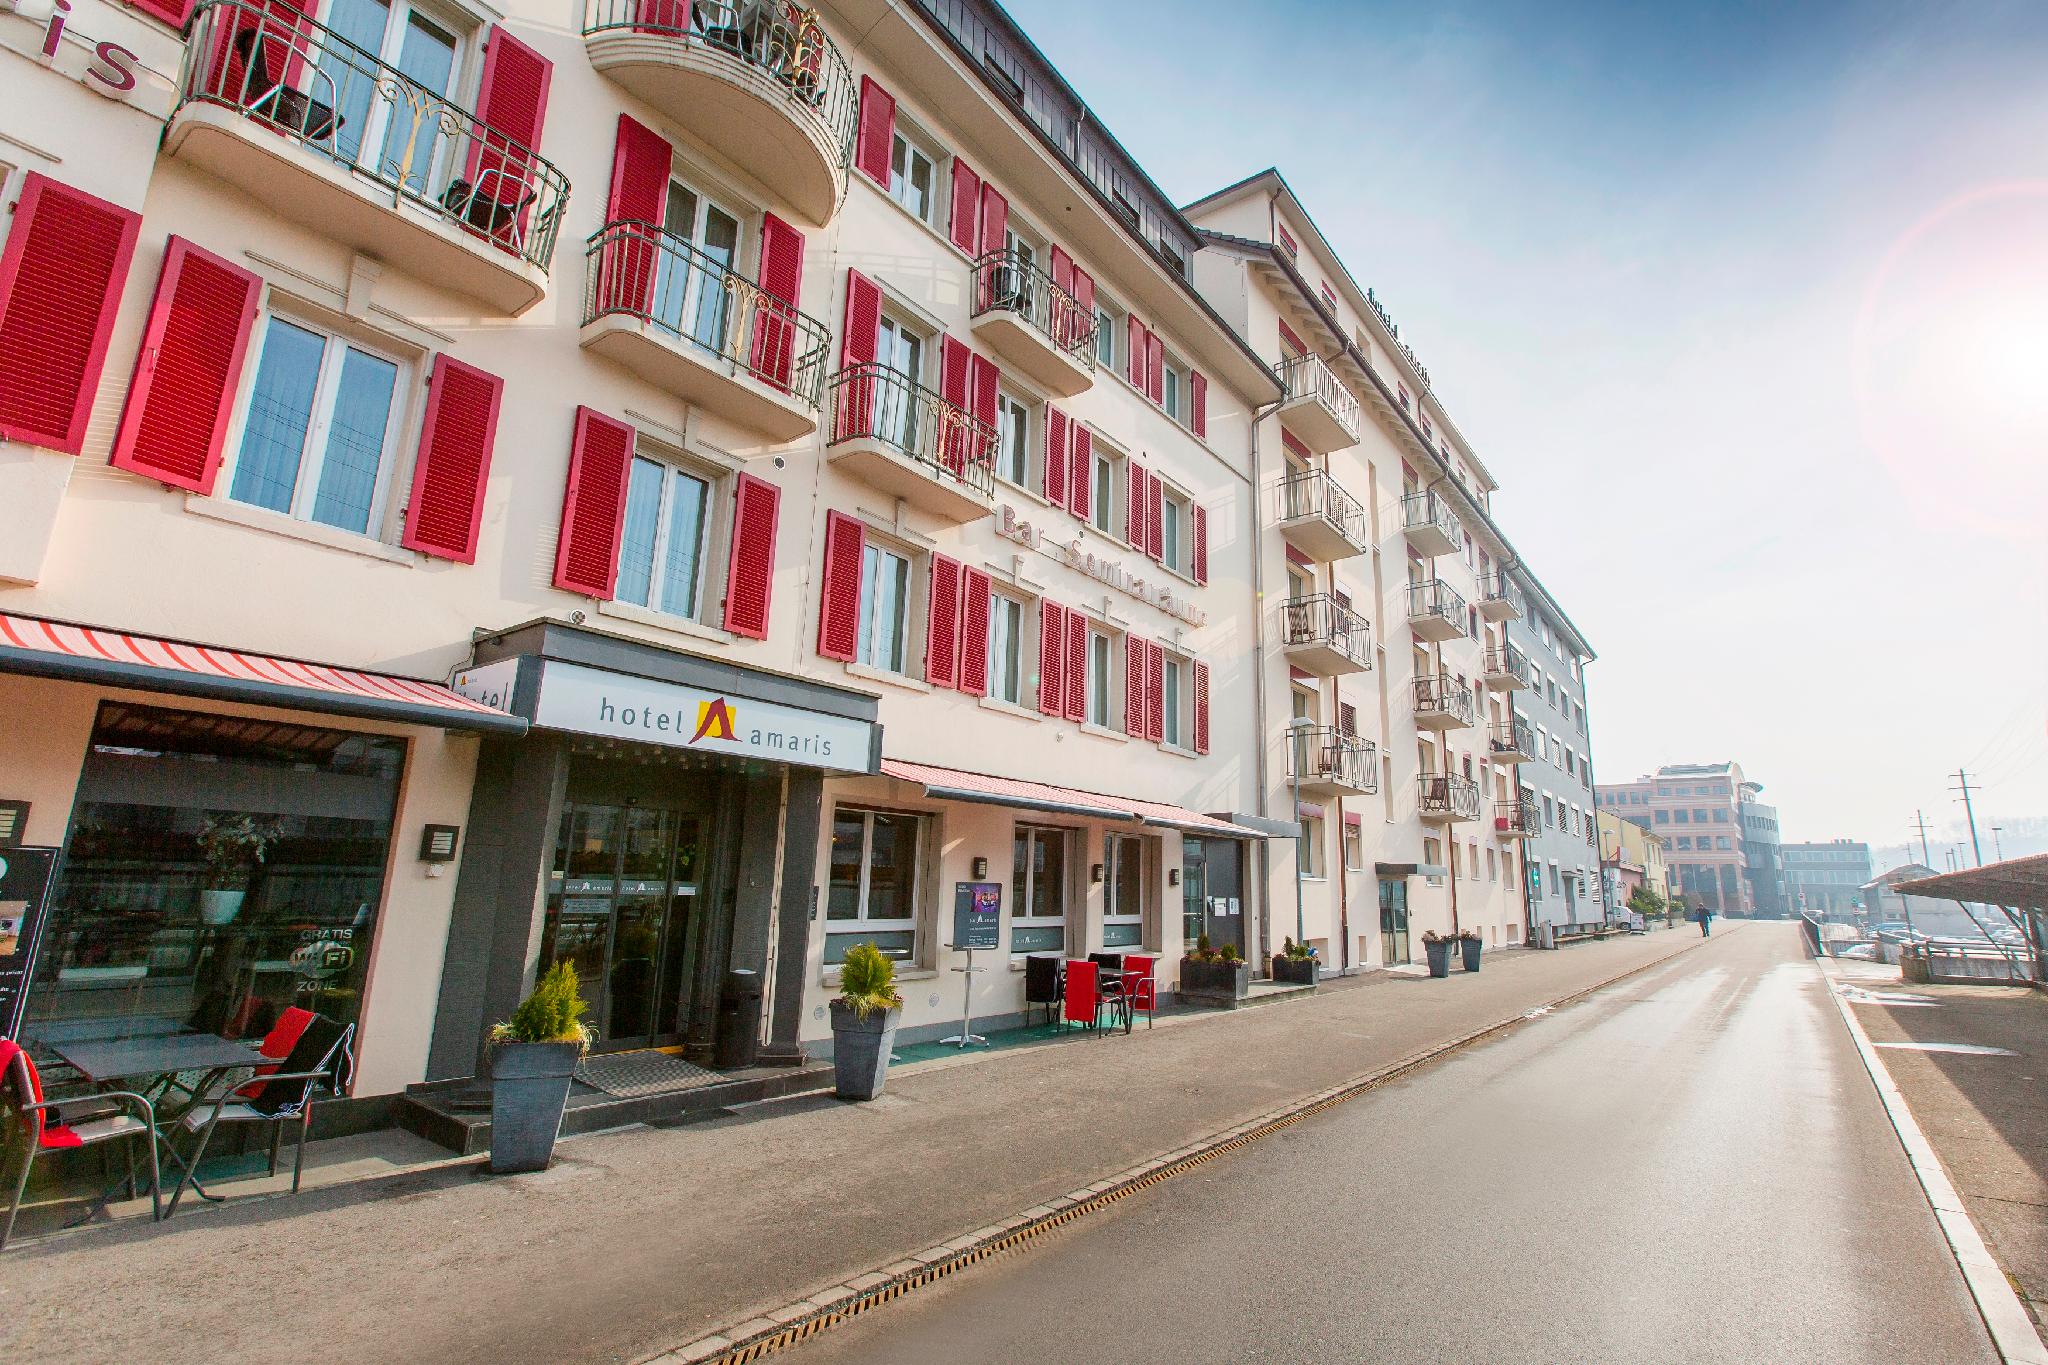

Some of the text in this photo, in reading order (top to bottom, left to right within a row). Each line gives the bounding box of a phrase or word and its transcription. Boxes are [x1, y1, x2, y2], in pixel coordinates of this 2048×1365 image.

[997, 504, 1045, 549] Bar
[462, 681, 509, 711] tel
[599, 696, 832, 756] hotel amaris
[301, 928, 353, 940] GRATIS
